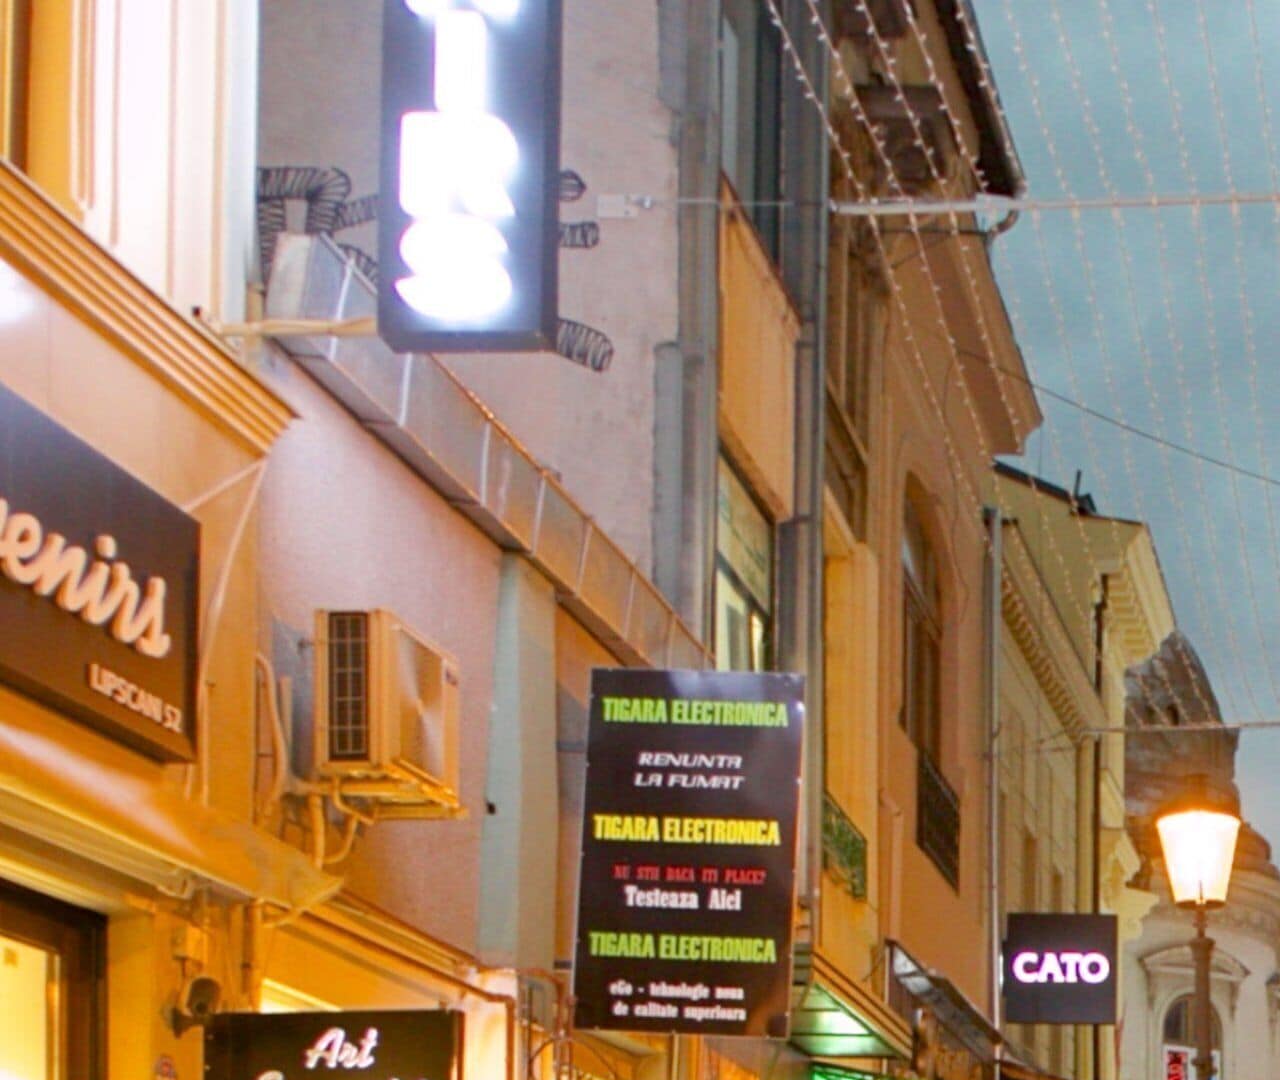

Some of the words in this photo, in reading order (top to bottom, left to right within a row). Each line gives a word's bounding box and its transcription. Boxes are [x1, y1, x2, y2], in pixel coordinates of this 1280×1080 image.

[394, 0, 518, 321] IRS
[602, 696, 668, 723] TIGARA
[670, 699, 789, 727] ELECTRONICA
[638, 752, 743, 769] RENUNTA
[633, 772, 661, 787] LA
[667, 774, 745, 790] FUMAT
[592, 814, 660, 841] TIGARA
[663, 817, 781, 846] ELECTRONICA
[624, 884, 700, 909] Testeaza
[708, 887, 742, 911] Aici
[589, 931, 656, 958] TIGARA
[659, 934, 777, 963] ELECTRONICA
[1012, 951, 1110, 984] CATO
[612, 1000, 630, 1017] de
[304, 1026, 379, 1069] Art
